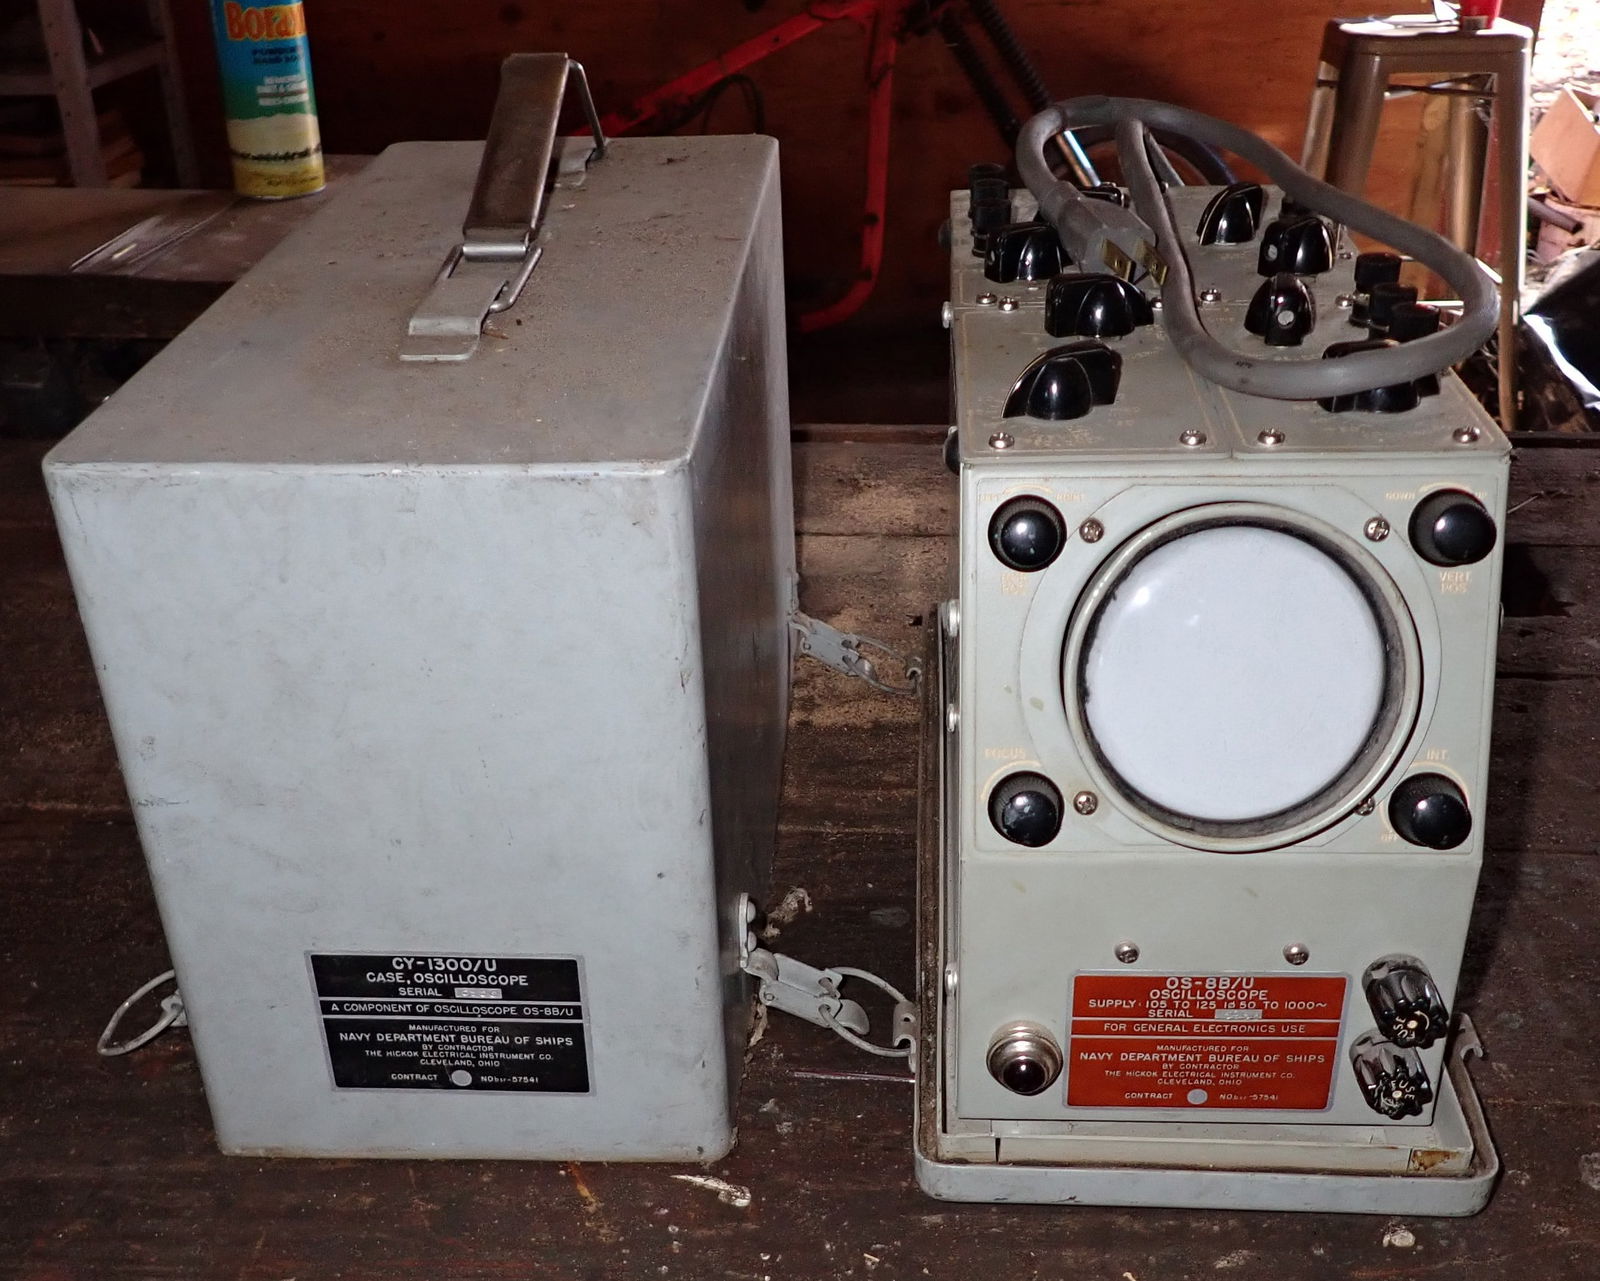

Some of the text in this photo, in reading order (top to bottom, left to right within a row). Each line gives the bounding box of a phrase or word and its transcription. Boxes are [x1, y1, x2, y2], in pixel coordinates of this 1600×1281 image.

[392, 958, 497, 972] CY-1300/U
[366, 972, 529, 986] CASE, OSCILLOSCOPE
[1166, 978, 1255, 990] OS-8B/U
[398, 987, 442, 996] SERIAL
[1150, 990, 1268, 1000] OSCILLOSCOPE
[344, 1004, 412, 1013] COMPONENT
[416, 1004, 430, 1013] OF
[434, 1005, 517, 1015] OSCILLOSCOPE
[523, 1007, 574, 1015] OS-8B/U
[1145, 1001, 1167, 1009] 105
[1173, 1001, 1189, 1009] TO
[1196, 1001, 1217, 1009] 125
[1240, 1001, 1255, 1009] 50
[1148, 1010, 1193, 1018] SERIAL
[1104, 1023, 1305, 1033] FOR GENERAL ELECTRONICS USE
[339, 1033, 573, 1045] NAVY DEPARTMENT BUREAU OF SHIPS
[420, 1059, 475, 1067] CLEVELAND,
[1080, 1053, 1325, 1063] NAVY DEPARTMENT BUREAU OF SHIPS
[391, 1073, 438, 1081] CONTRACT
